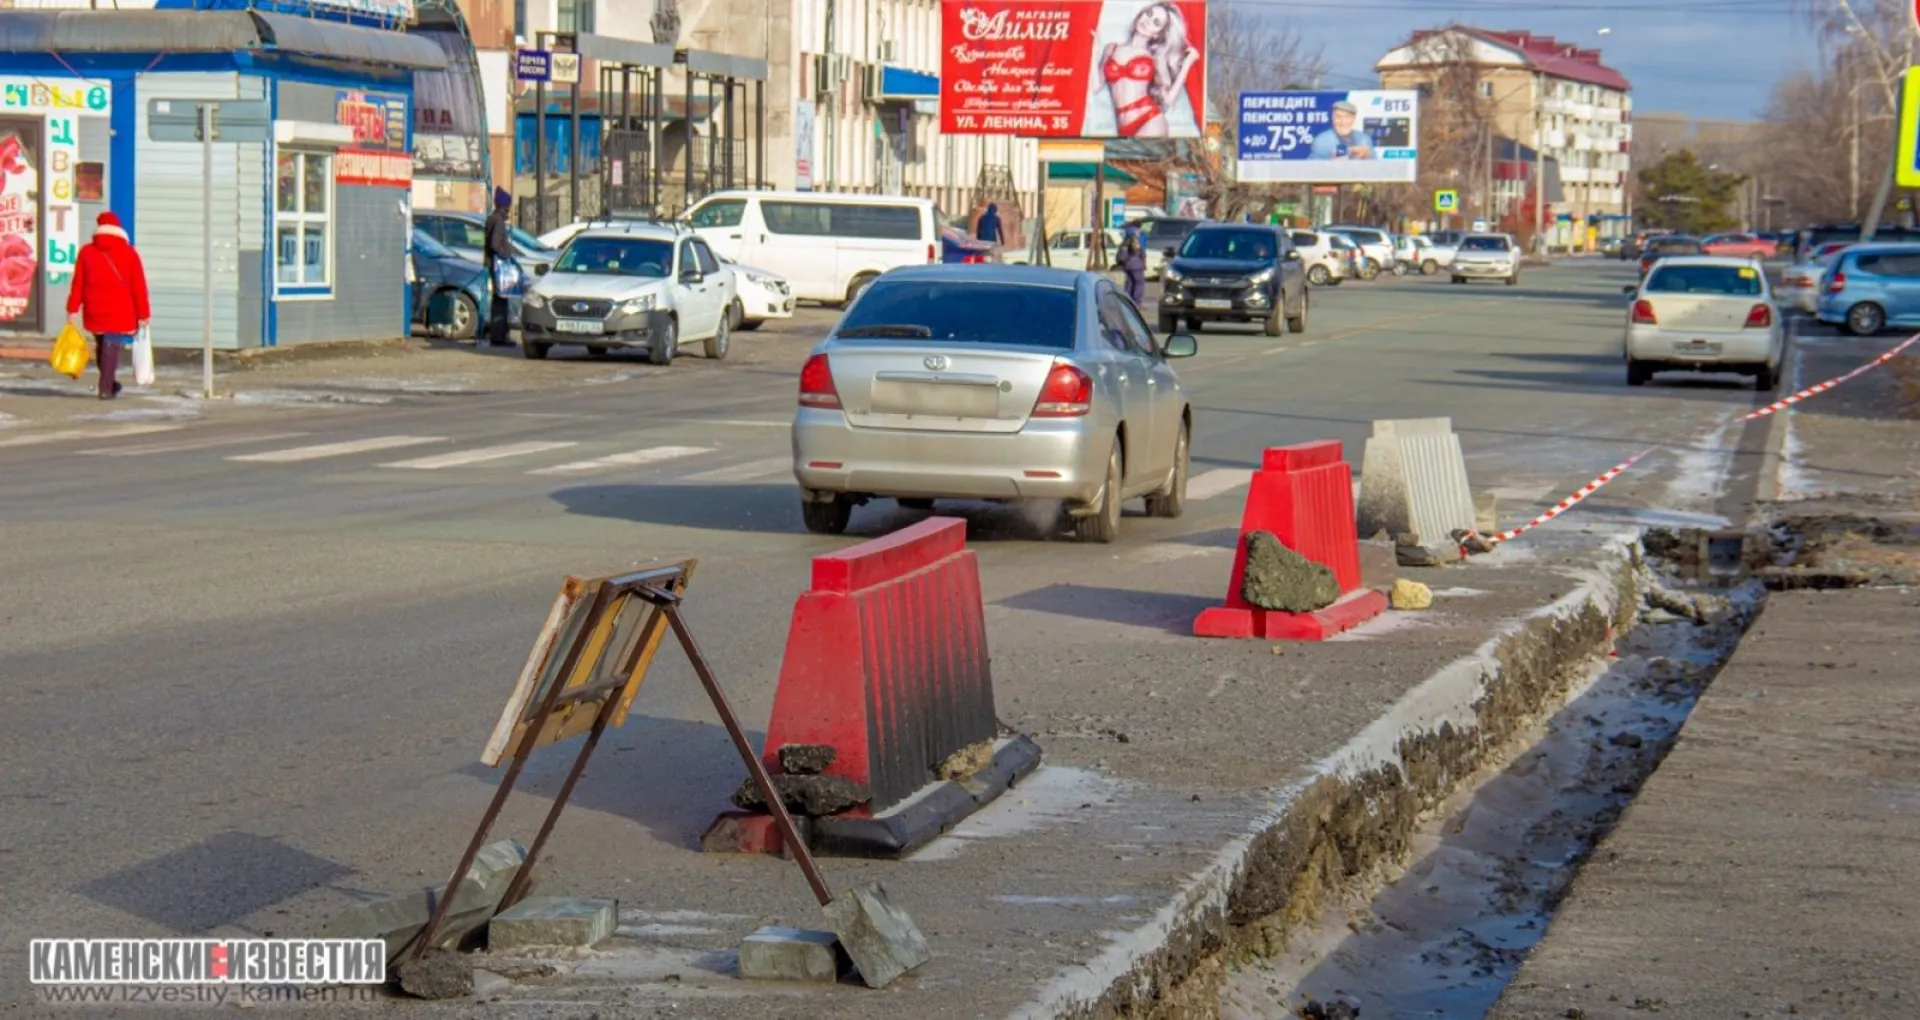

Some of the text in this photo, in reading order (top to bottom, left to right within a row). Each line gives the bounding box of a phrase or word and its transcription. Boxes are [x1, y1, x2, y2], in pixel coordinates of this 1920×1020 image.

[1016, 11, 1070, 20] МАГАЗИН
[520, 55, 546, 66] ПОЧТА
[1243, 96, 1316, 110] ПЕРЕВЕДИТЕ
[1384, 98, 1410, 112] ВТБ
[956, 115, 1070, 132] УЛ. ЛЕНИНА, 35
[1243, 111, 1329, 124] ПЕНСИЮ В ВТБ
